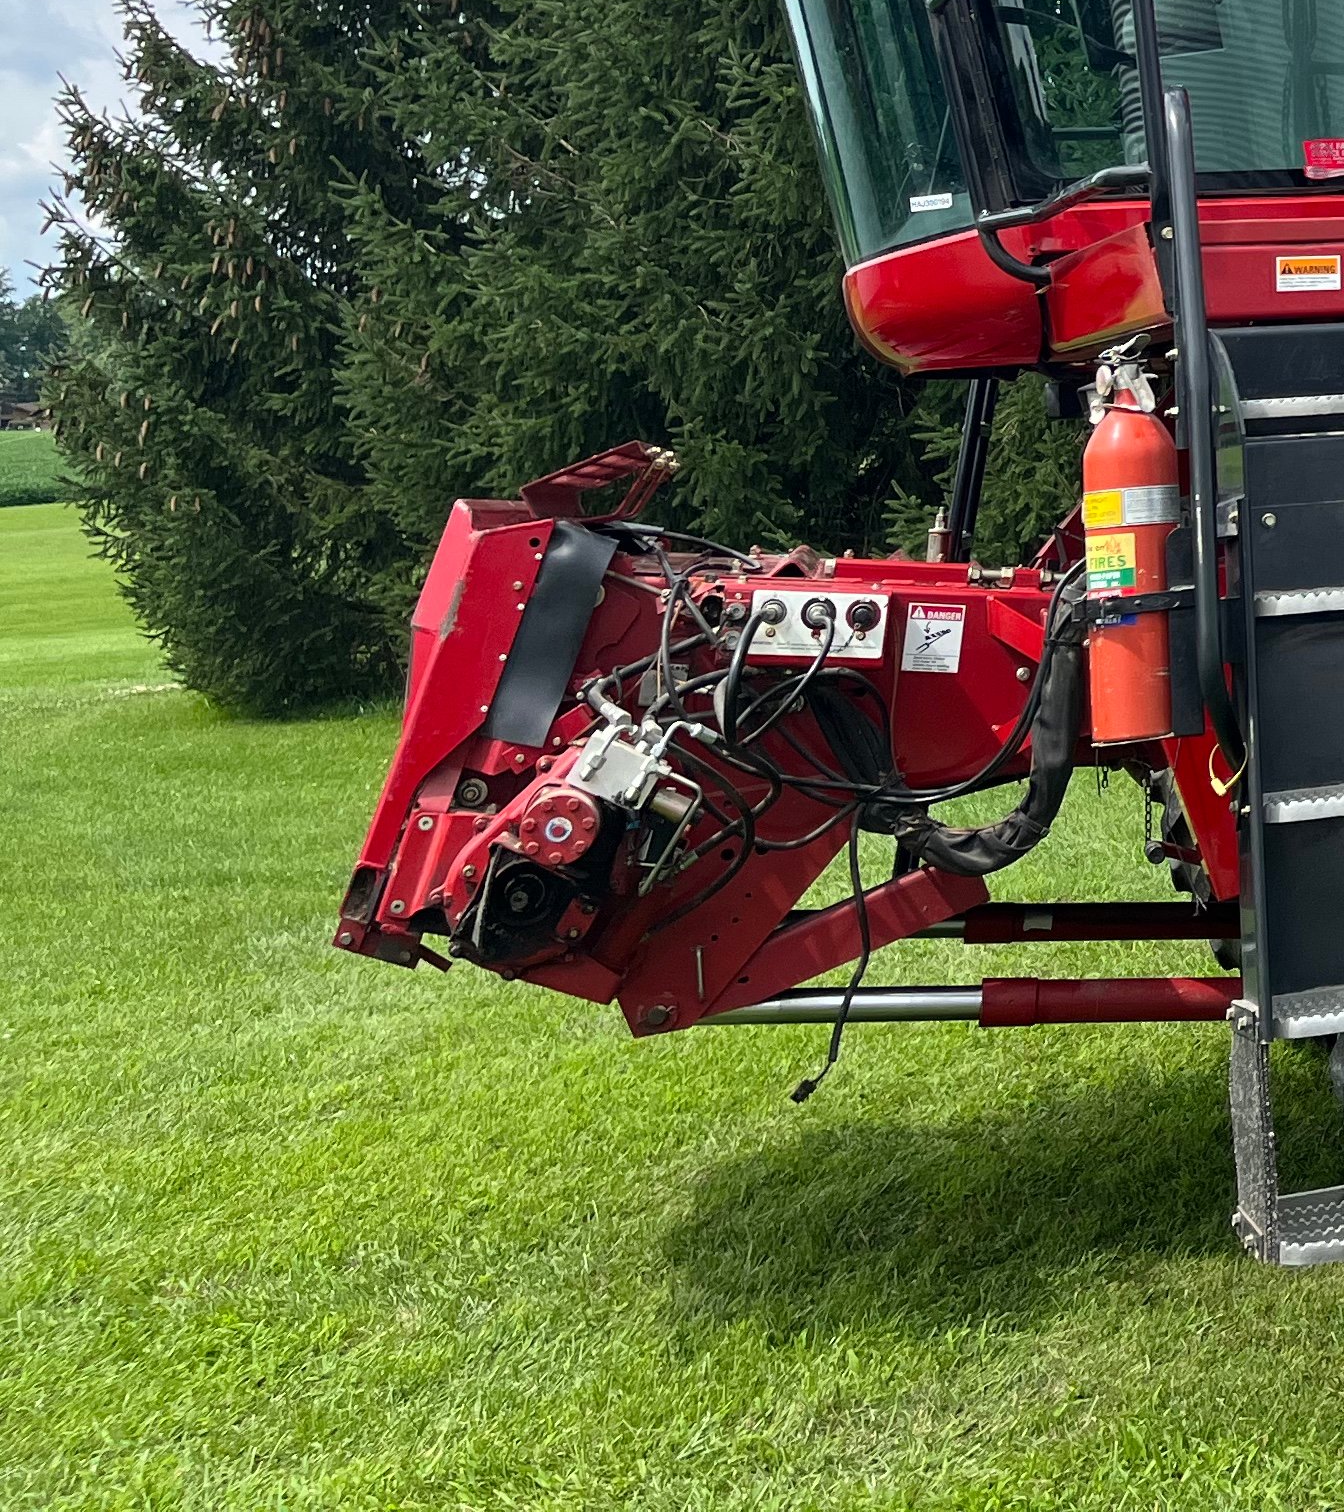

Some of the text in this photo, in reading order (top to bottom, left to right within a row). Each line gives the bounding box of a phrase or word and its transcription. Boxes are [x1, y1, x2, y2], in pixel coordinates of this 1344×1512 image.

[1293, 265, 1336, 275] WARNING
[1089, 555, 1127, 570] FIRES
[927, 610, 962, 621] DANGER
